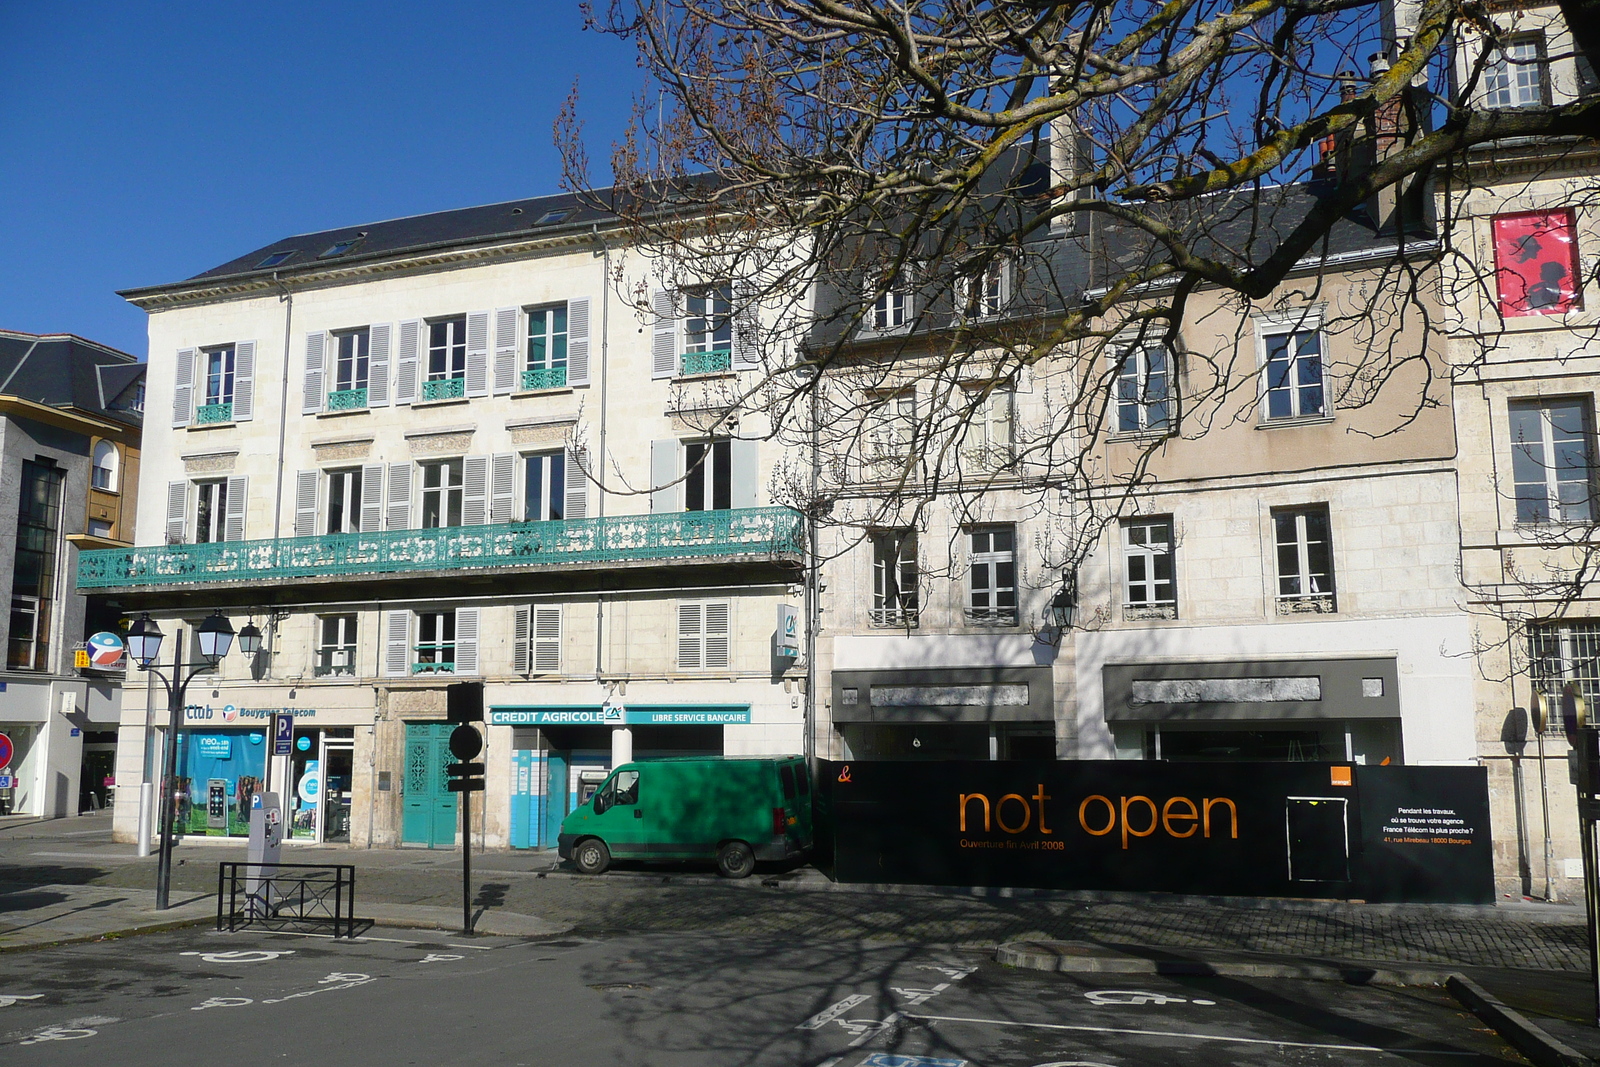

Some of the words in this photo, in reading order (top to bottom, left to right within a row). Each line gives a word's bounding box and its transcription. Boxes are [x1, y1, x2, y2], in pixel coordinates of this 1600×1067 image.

[186, 704, 213, 719] Club
[282, 707, 316, 717] Telecom
[541, 712, 604, 722] AGRICOLE
[652, 714, 672, 722] LIBRE
[674, 714, 706, 722] SERVICE
[707, 714, 746, 722] BANCAIRE
[278, 718, 287, 737] P
[201, 737, 217, 746] neo
[252, 795, 260, 808] P
[959, 783, 1052, 834] not
[1078, 794, 1238, 850] open
[960, 838, 1004, 849] Ouverture
[1006, 839, 1017, 849] fin
[1019, 840, 1039, 849] Avril
[1041, 841, 1065, 850] 2008
